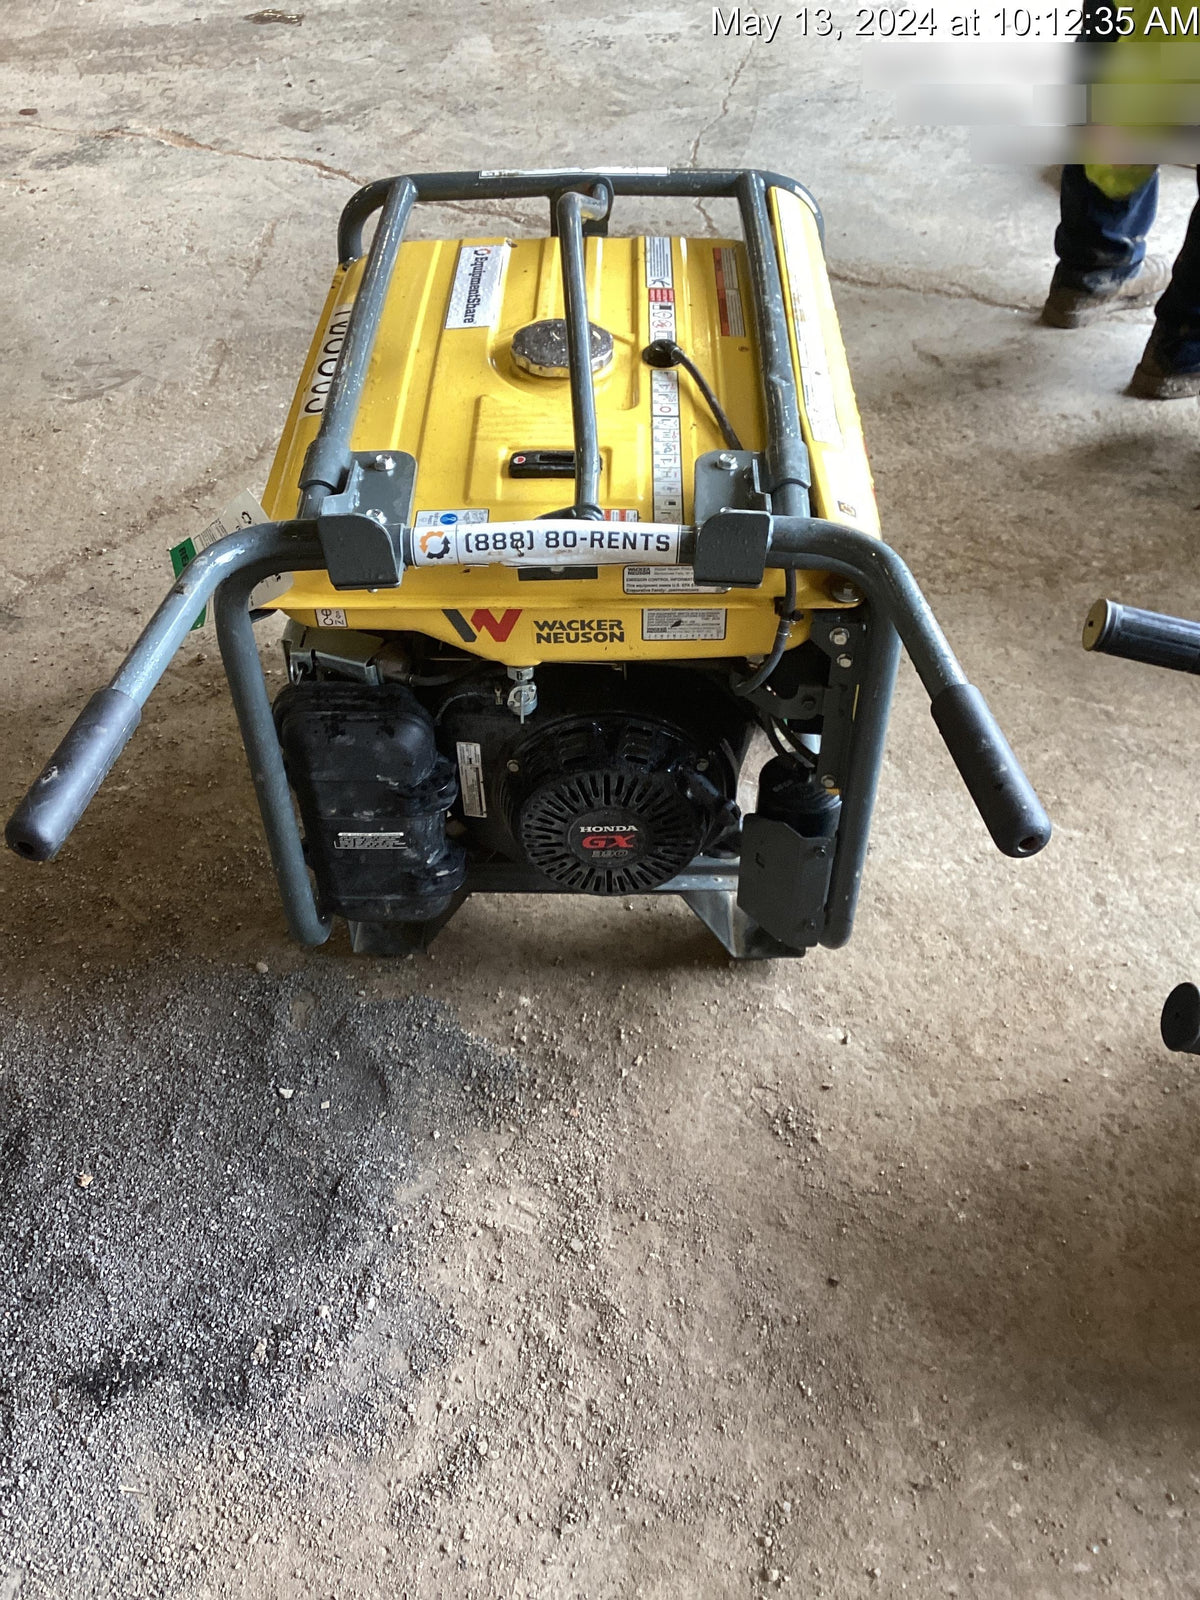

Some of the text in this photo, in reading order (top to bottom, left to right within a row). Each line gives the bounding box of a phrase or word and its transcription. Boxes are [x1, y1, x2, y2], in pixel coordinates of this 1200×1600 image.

[463, 256, 488, 324] EquipmentShare
[464, 530, 671, 552] (888) 80-RENTS
[533, 619, 624, 632] WACKER
[535, 631, 625, 644] NEUSON
[582, 835, 635, 848] GX
